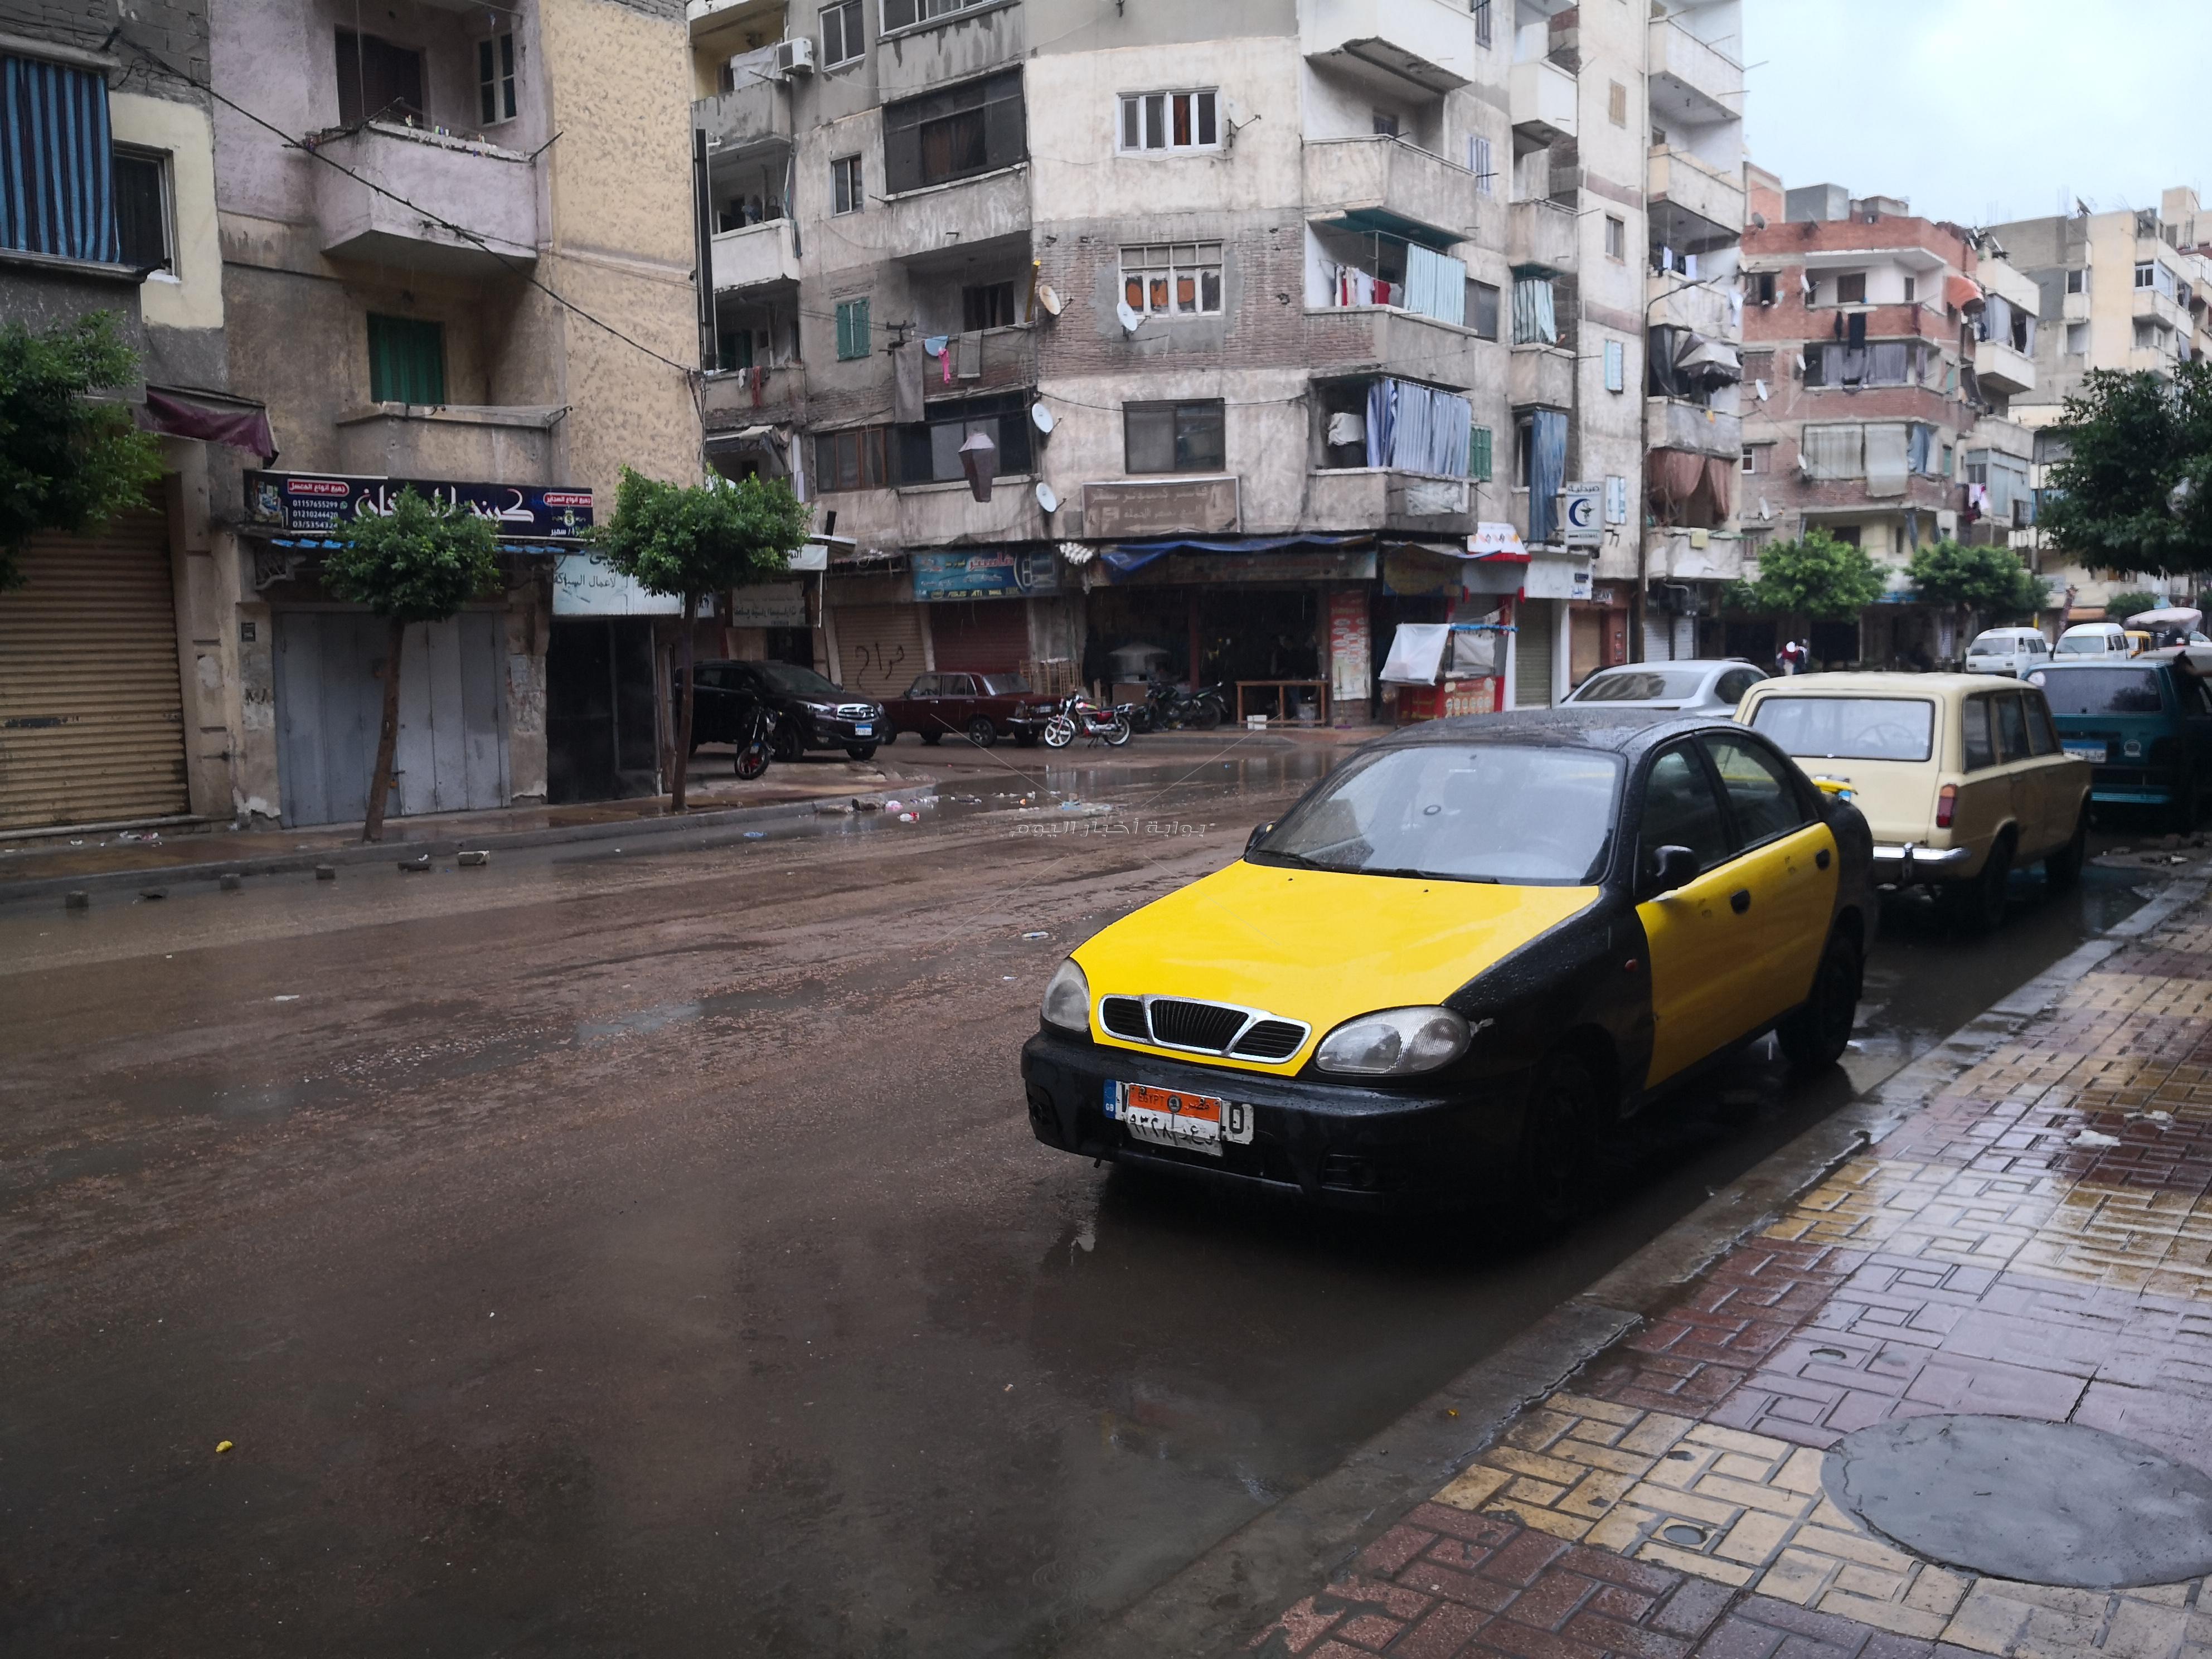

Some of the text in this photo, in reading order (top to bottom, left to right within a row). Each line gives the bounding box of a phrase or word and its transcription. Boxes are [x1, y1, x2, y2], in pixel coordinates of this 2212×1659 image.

[1568, 484, 1600, 493] صيدلية
[1138, 1090, 1165, 1105] EGYPT
[1105, 1102, 1114, 1112] GB
[1184, 1100, 1210, 1111] مصر
